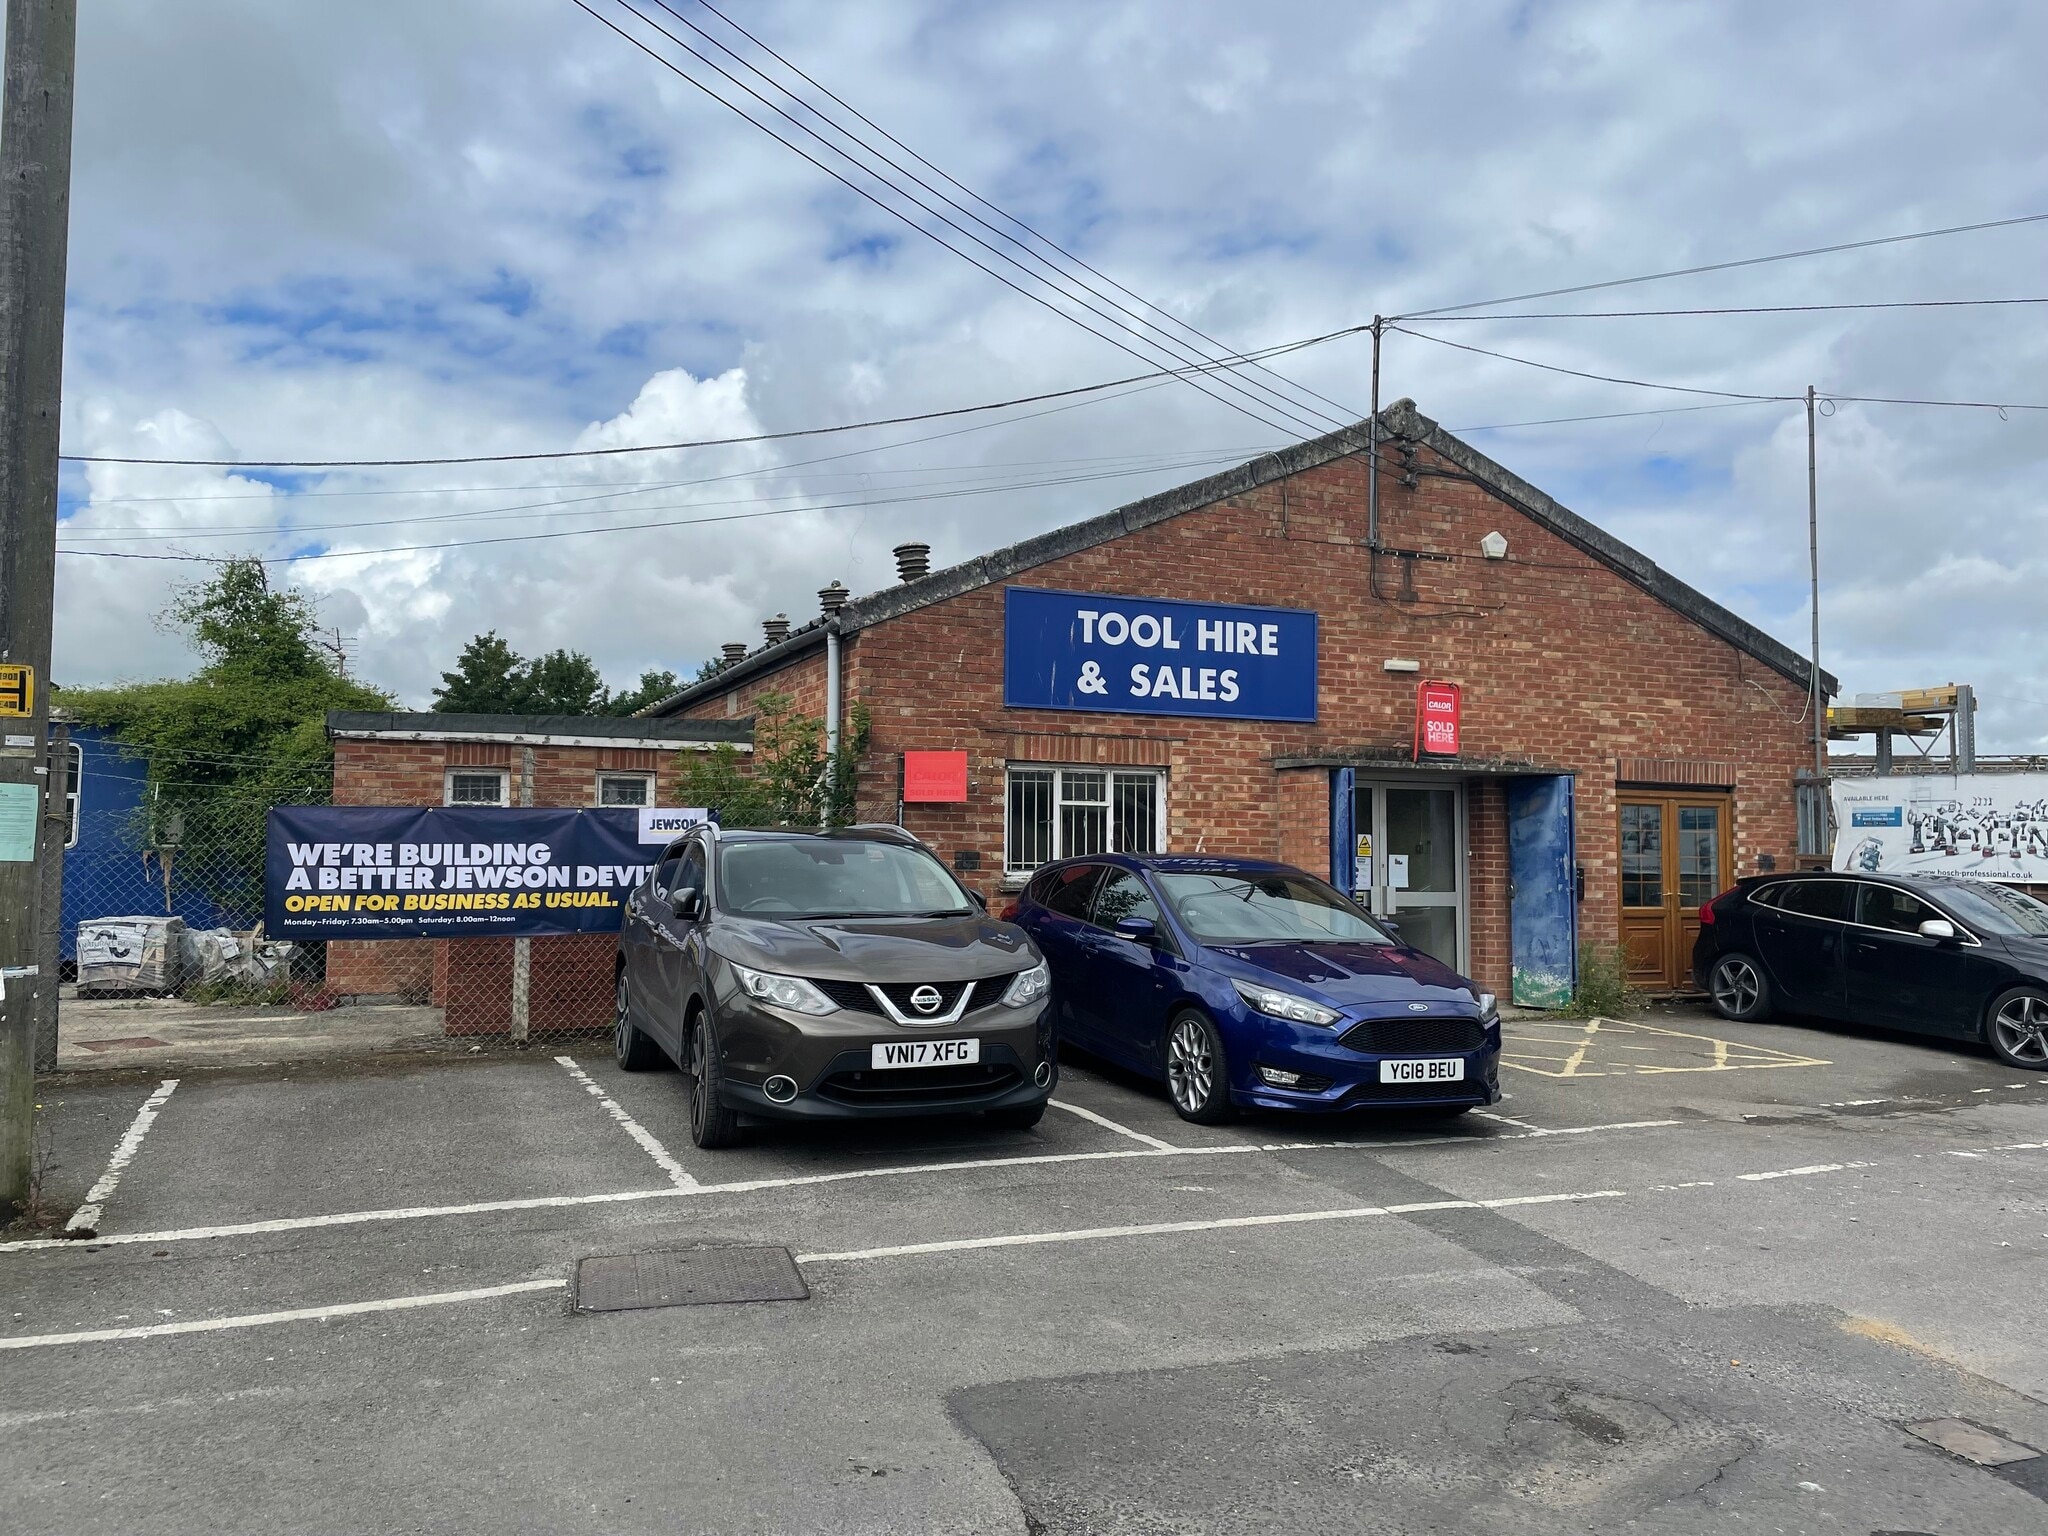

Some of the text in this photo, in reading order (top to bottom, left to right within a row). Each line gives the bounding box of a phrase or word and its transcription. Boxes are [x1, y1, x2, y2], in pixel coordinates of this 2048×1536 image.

[1077, 610, 1279, 656] TOOL HIRE
[1077, 660, 1240, 702] & SALES
[1428, 701, 1452, 711] CALOR
[1427, 720, 1455, 733] SOLD
[1428, 732, 1455, 743] HERE
[649, 818, 698, 831] JEWSON
[286, 843, 552, 867] WE’RE BUILDING
[284, 867, 313, 891] A
[318, 867, 436, 890] BETTER
[439, 866, 568, 889] JEWSON
[1916, 868, 2034, 879] wwwbosch-professional.co.uk
[285, 891, 619, 913] OPEN FOR BUSINESS AS USUAL.
[418, 916, 455, 925] Saturday:
[914, 995, 940, 1003] NISSAN
[884, 1041, 969, 1065] VN17 XFG
[1390, 1061, 1457, 1080] YG18 BEU
